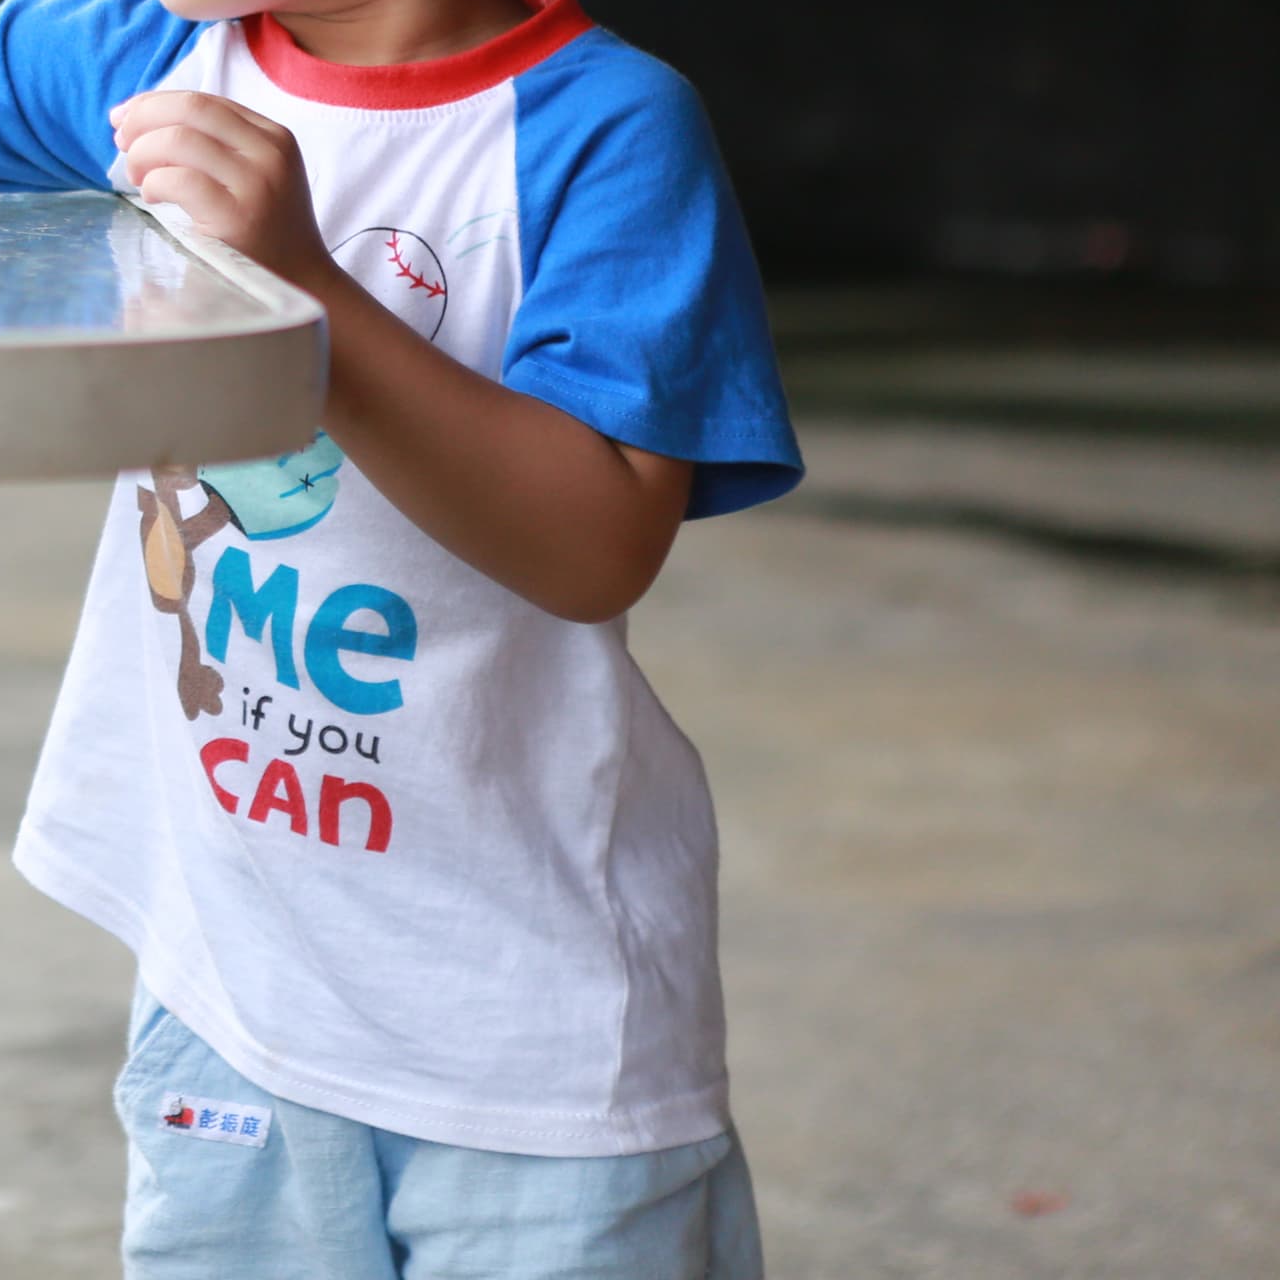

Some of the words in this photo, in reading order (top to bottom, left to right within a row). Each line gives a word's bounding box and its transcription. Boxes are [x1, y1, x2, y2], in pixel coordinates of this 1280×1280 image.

[206, 546, 417, 714] Me
[242, 687, 273, 730] if
[284, 713, 380, 763] you
